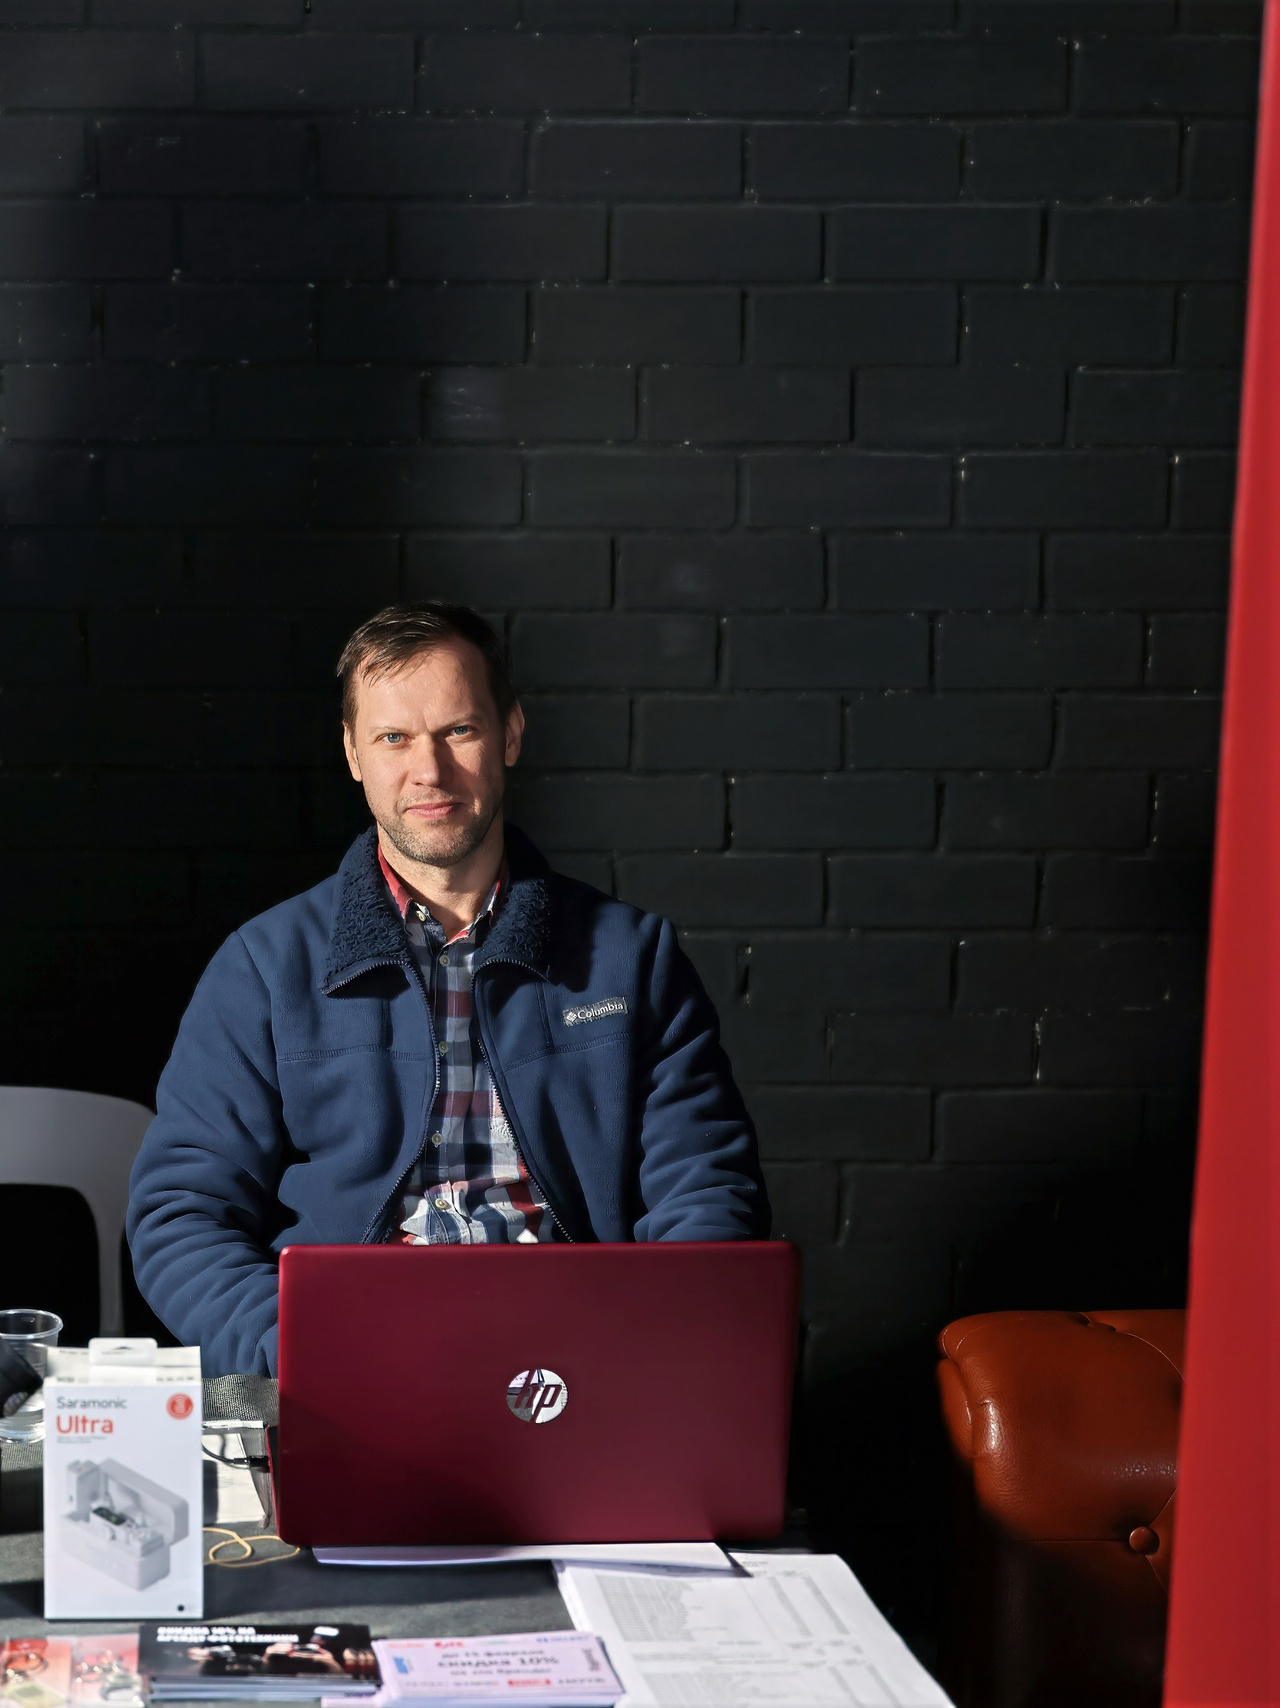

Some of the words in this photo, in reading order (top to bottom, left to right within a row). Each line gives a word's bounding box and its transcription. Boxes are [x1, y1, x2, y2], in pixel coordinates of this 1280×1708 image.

[577, 1000, 624, 1019] Columbia
[56, 1395, 128, 1410] Saramonic
[511, 1369, 565, 1424] hp
[56, 1414, 115, 1435] Ultra
